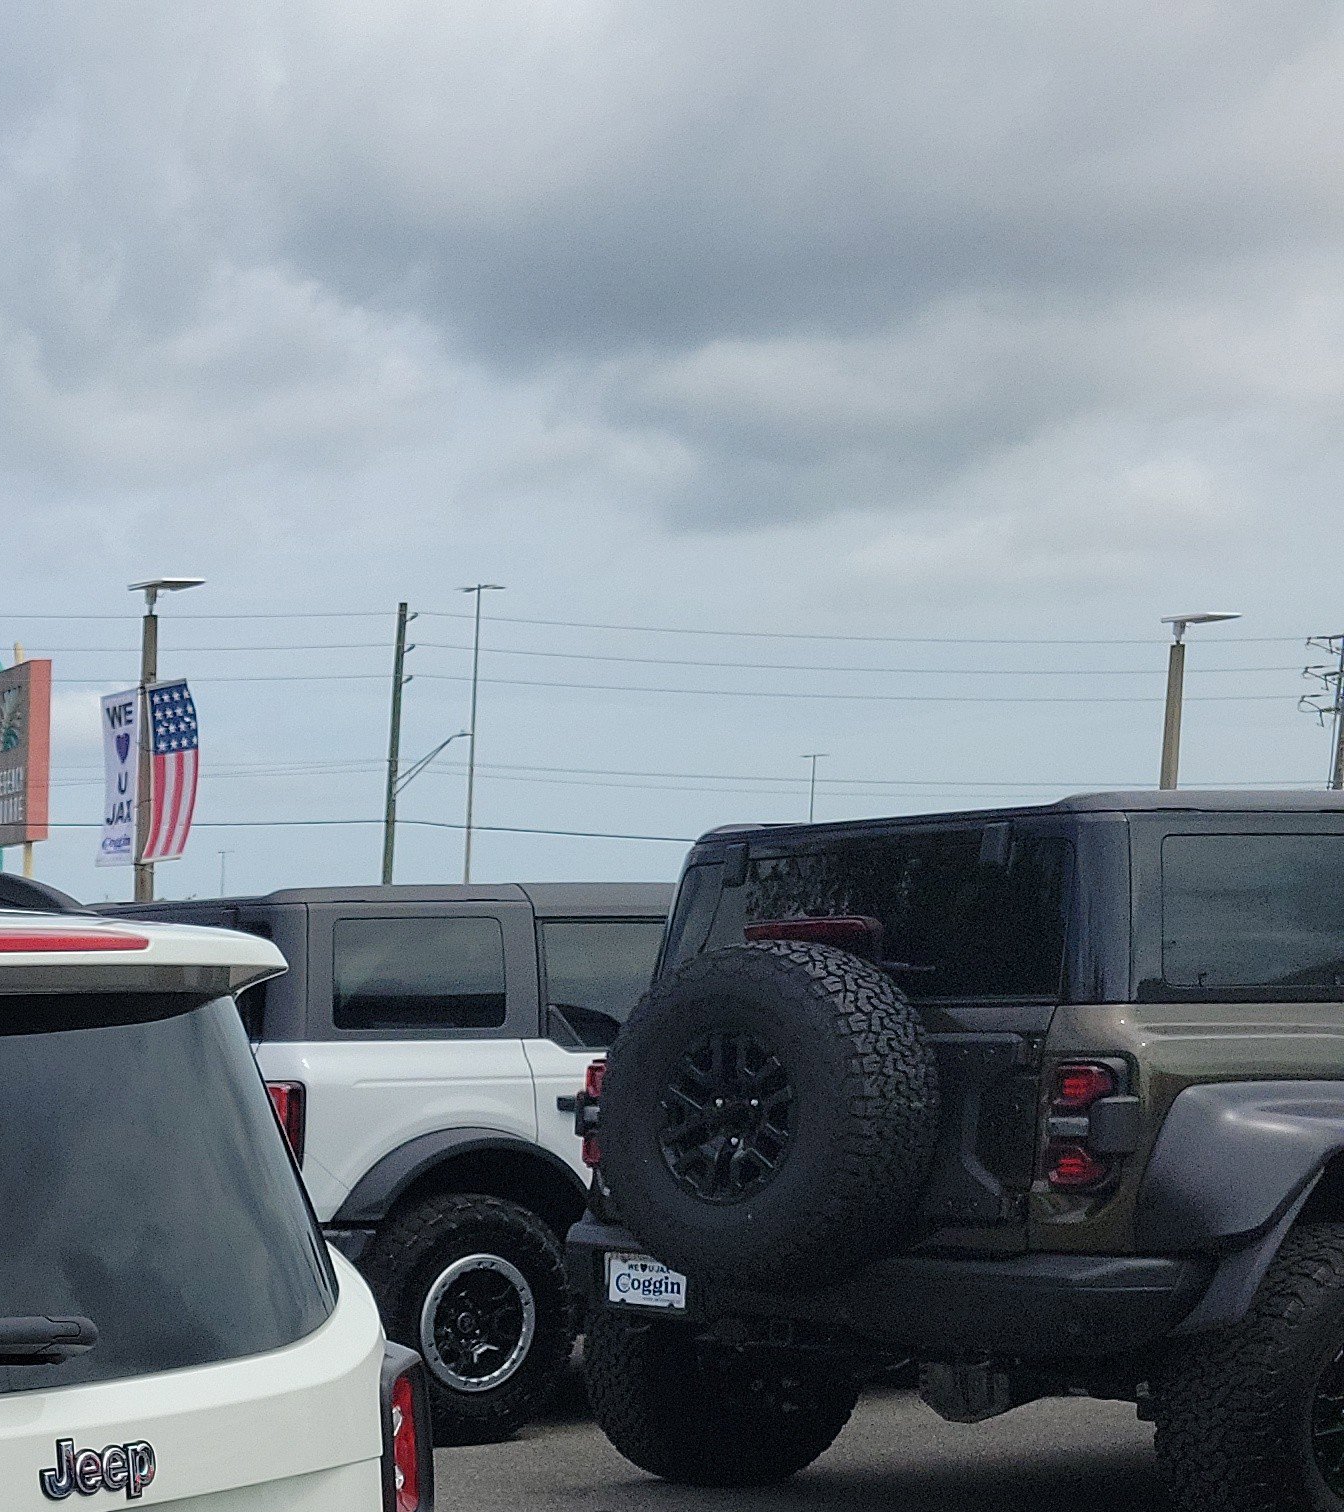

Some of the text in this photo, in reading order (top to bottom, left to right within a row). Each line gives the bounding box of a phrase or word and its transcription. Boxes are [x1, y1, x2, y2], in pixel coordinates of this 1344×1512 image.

[106, 702, 133, 729] WE
[117, 772, 128, 795] U
[106, 800, 132, 826] JAX
[615, 1272, 681, 1296] Coggin
[39, 1438, 156, 1500] Jeep
